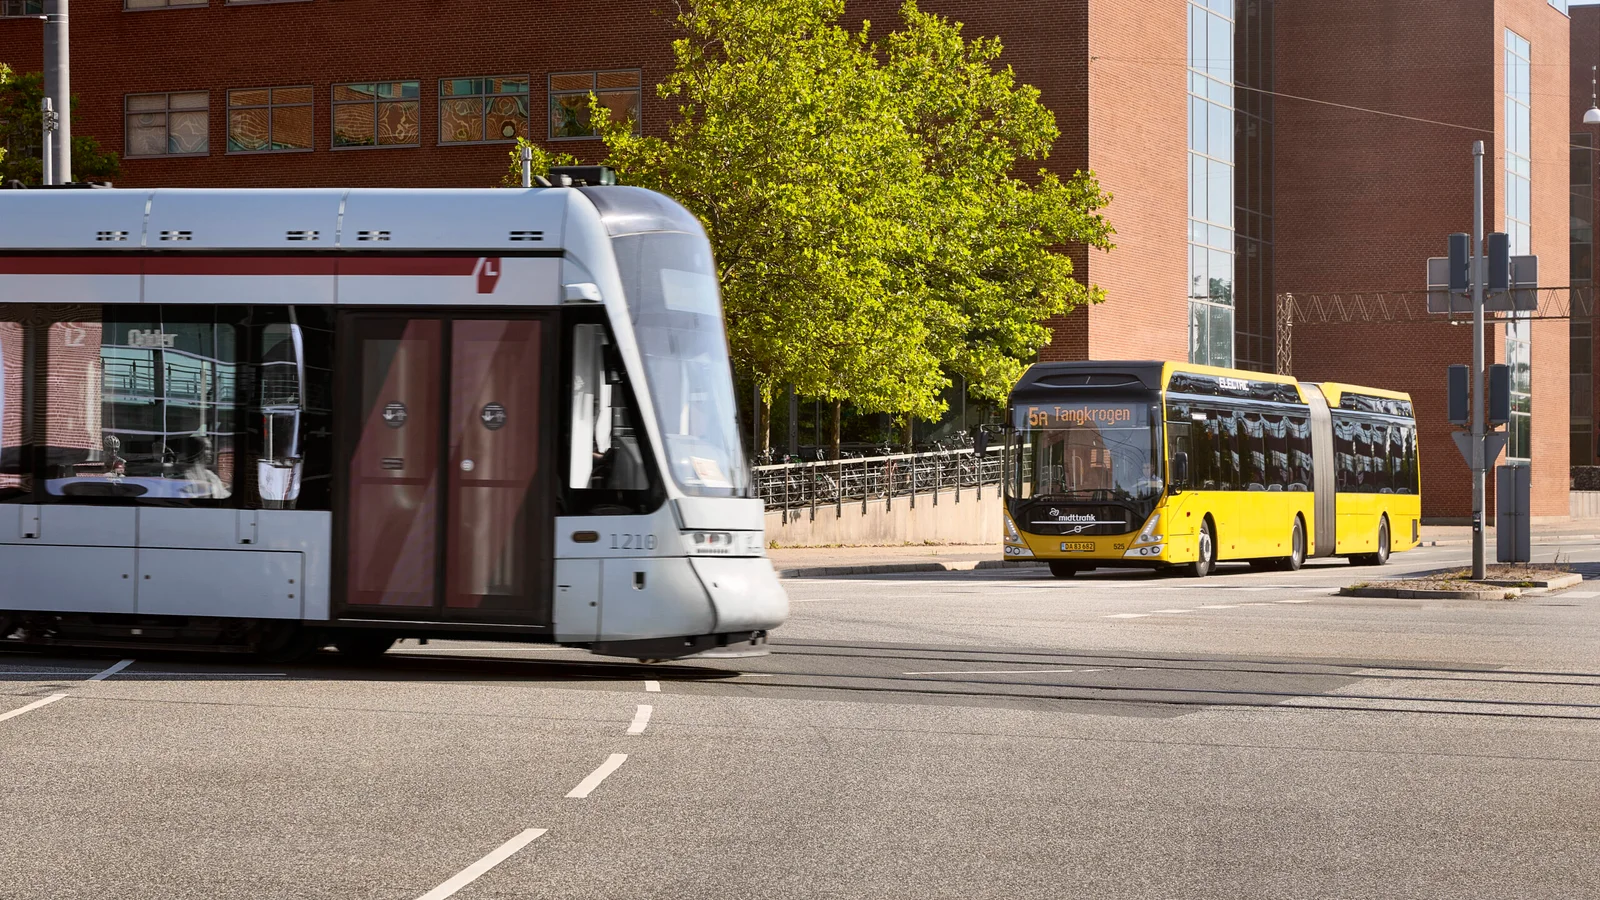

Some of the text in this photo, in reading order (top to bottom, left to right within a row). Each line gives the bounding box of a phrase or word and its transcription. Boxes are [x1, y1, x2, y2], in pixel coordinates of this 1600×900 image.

[1218, 376, 1250, 391] ELECTRIC
[1028, 406, 1130, 426] 5A Tangkrogen
